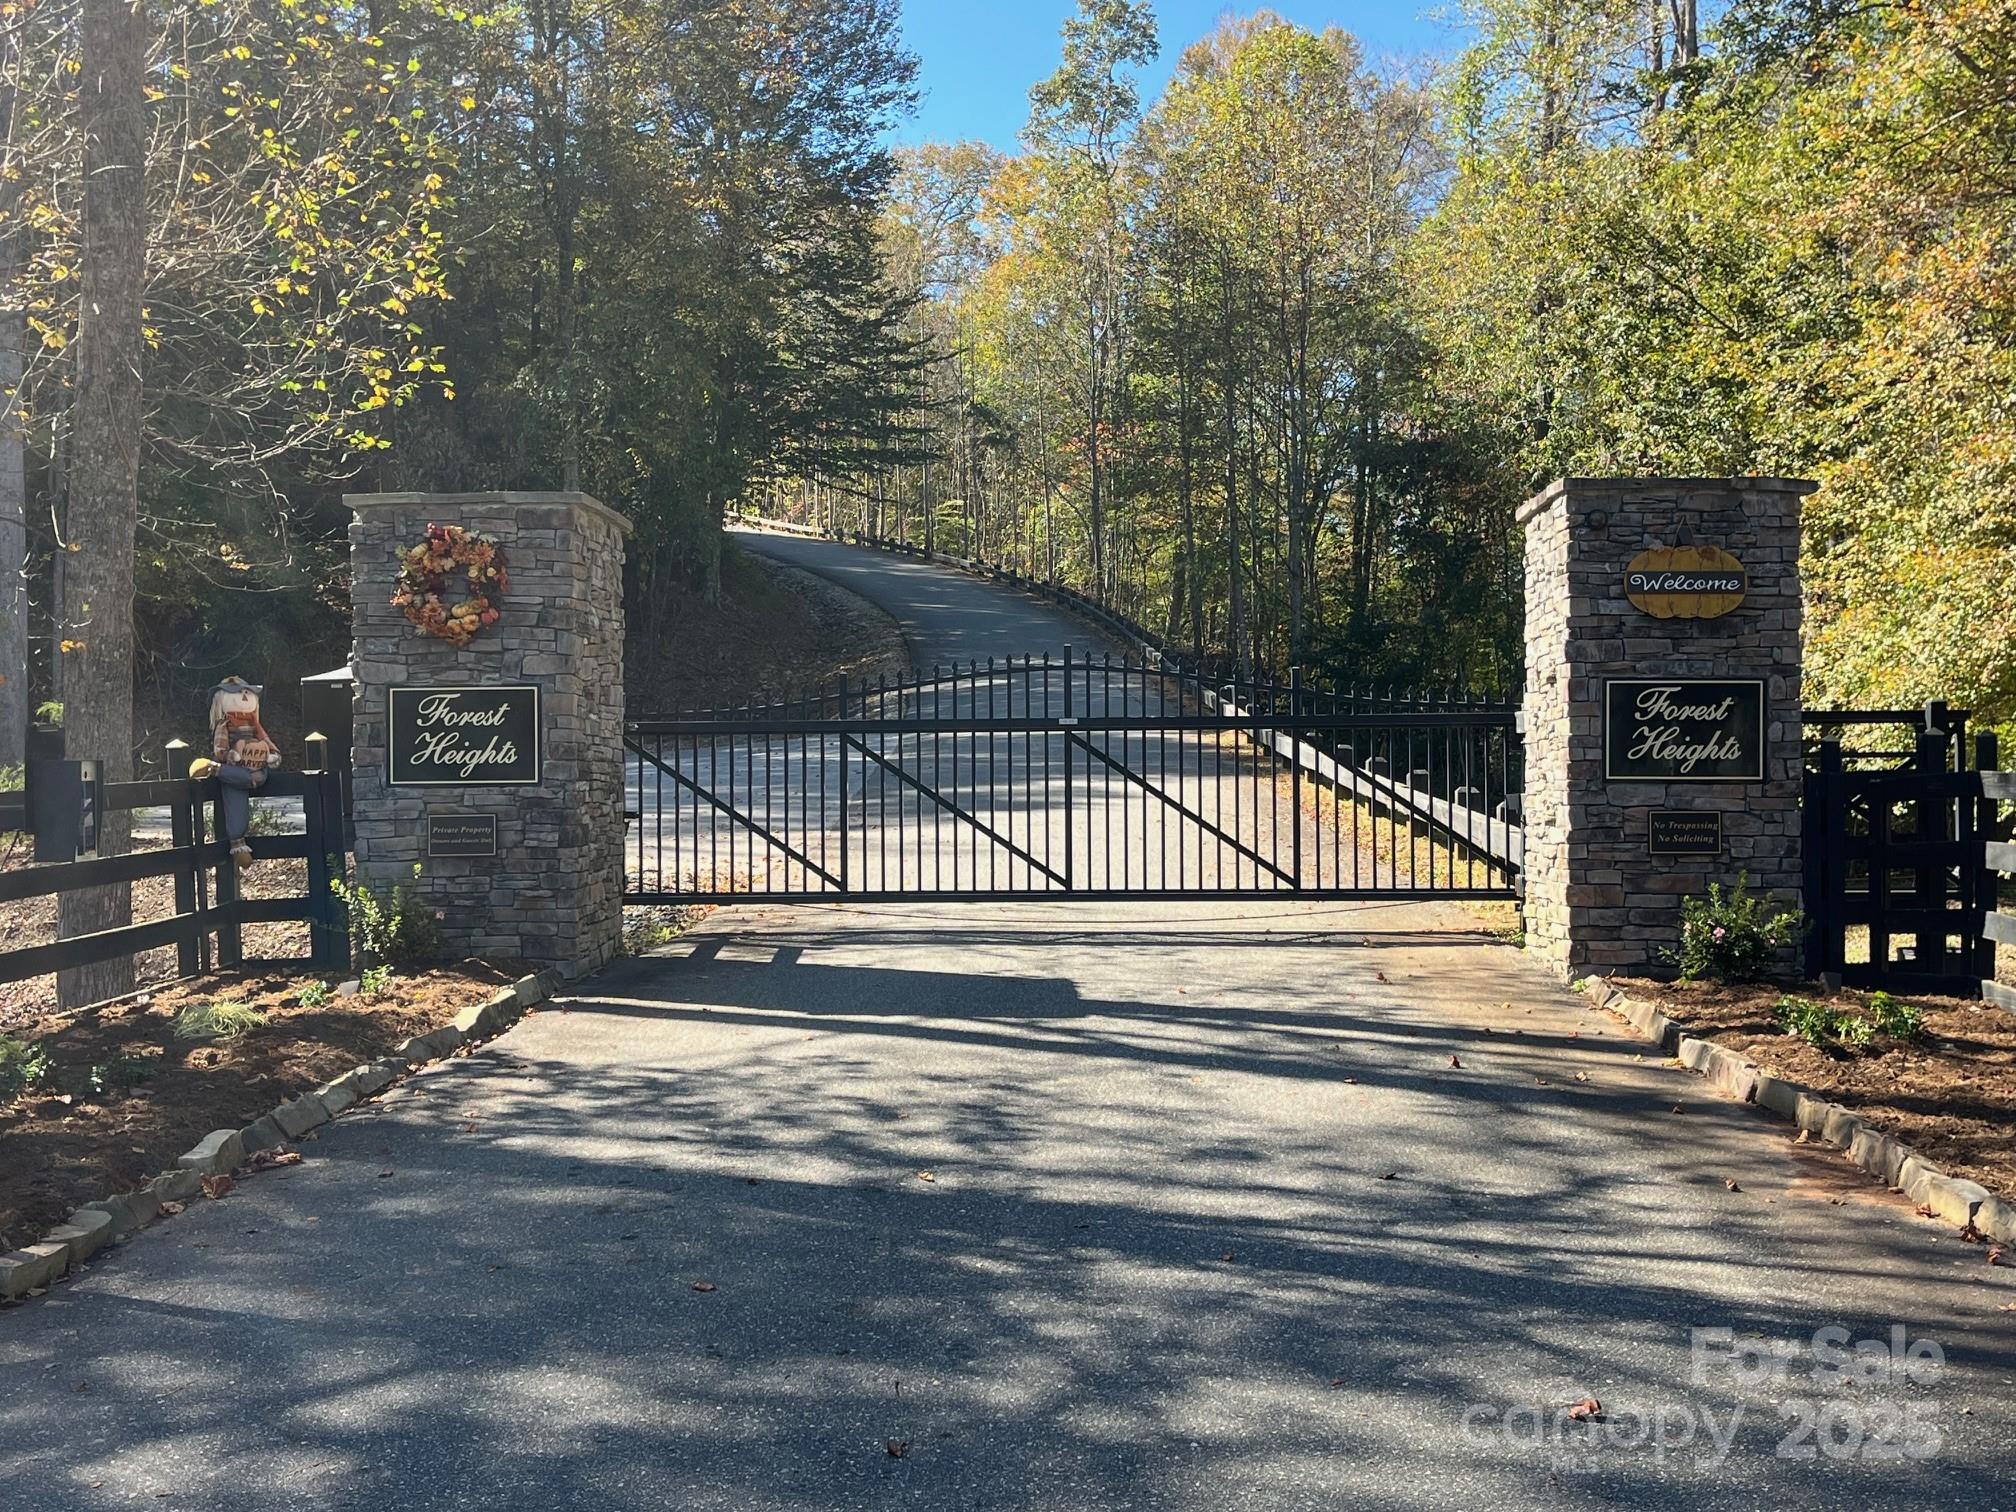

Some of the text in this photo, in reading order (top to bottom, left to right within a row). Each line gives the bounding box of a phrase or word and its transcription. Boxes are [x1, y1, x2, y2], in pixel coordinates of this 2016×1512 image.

[1630, 573, 1740, 591] Welcome
[416, 693, 511, 727] Forest
[1634, 687, 1735, 720] Forest
[410, 732, 518, 778] Heights
[1627, 726, 1742, 773] Heights
[461, 826, 492, 834] Property
[1653, 821, 1719, 831] No Trespassing
[1658, 834, 1714, 844] No Soliciting
